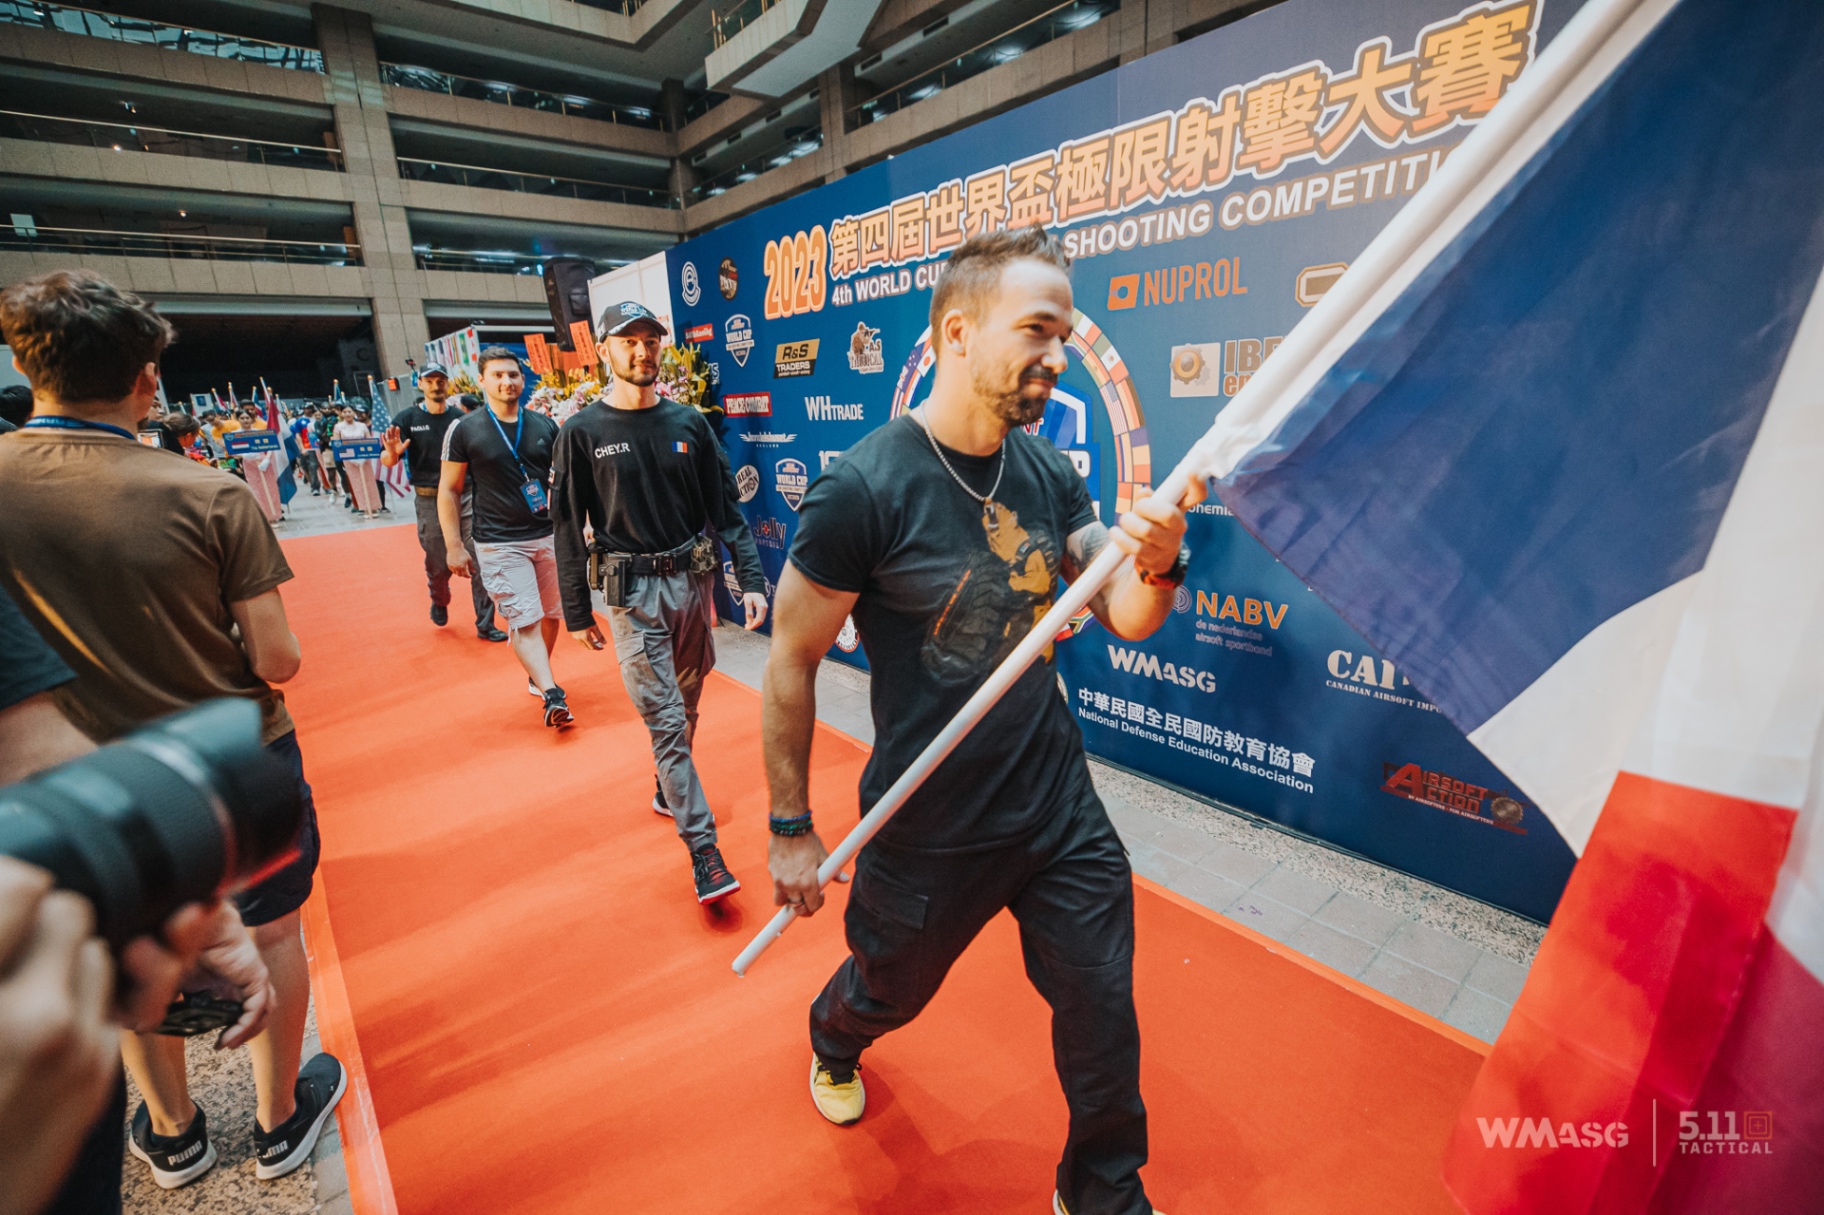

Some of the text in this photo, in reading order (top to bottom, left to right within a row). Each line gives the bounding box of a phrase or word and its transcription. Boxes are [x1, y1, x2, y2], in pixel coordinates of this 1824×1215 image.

[1064, 149, 1441, 259] SHOOTING COMPETITI
[764, 225, 827, 320] 2023
[832, 261, 947, 305] 4th WORLD CU
[1144, 257, 1248, 306] NUPROL
[776, 361, 811, 372] TRADERS
[782, 344, 809, 360] R&S
[594, 442, 631, 459] CHEY.R
[752, 515, 787, 550] Jolly
[1196, 589, 1289, 630] NABV
[1107, 644, 1216, 693] WMASG
[1326, 679, 1371, 697] CANADIAN
[1373, 691, 1415, 707] AIRSOFT
[1078, 687, 1316, 778] 中華民國全民國防教育協會
[1078, 707, 1315, 794] National Defense Education Association
[167, 1140, 203, 1166] PUMA
